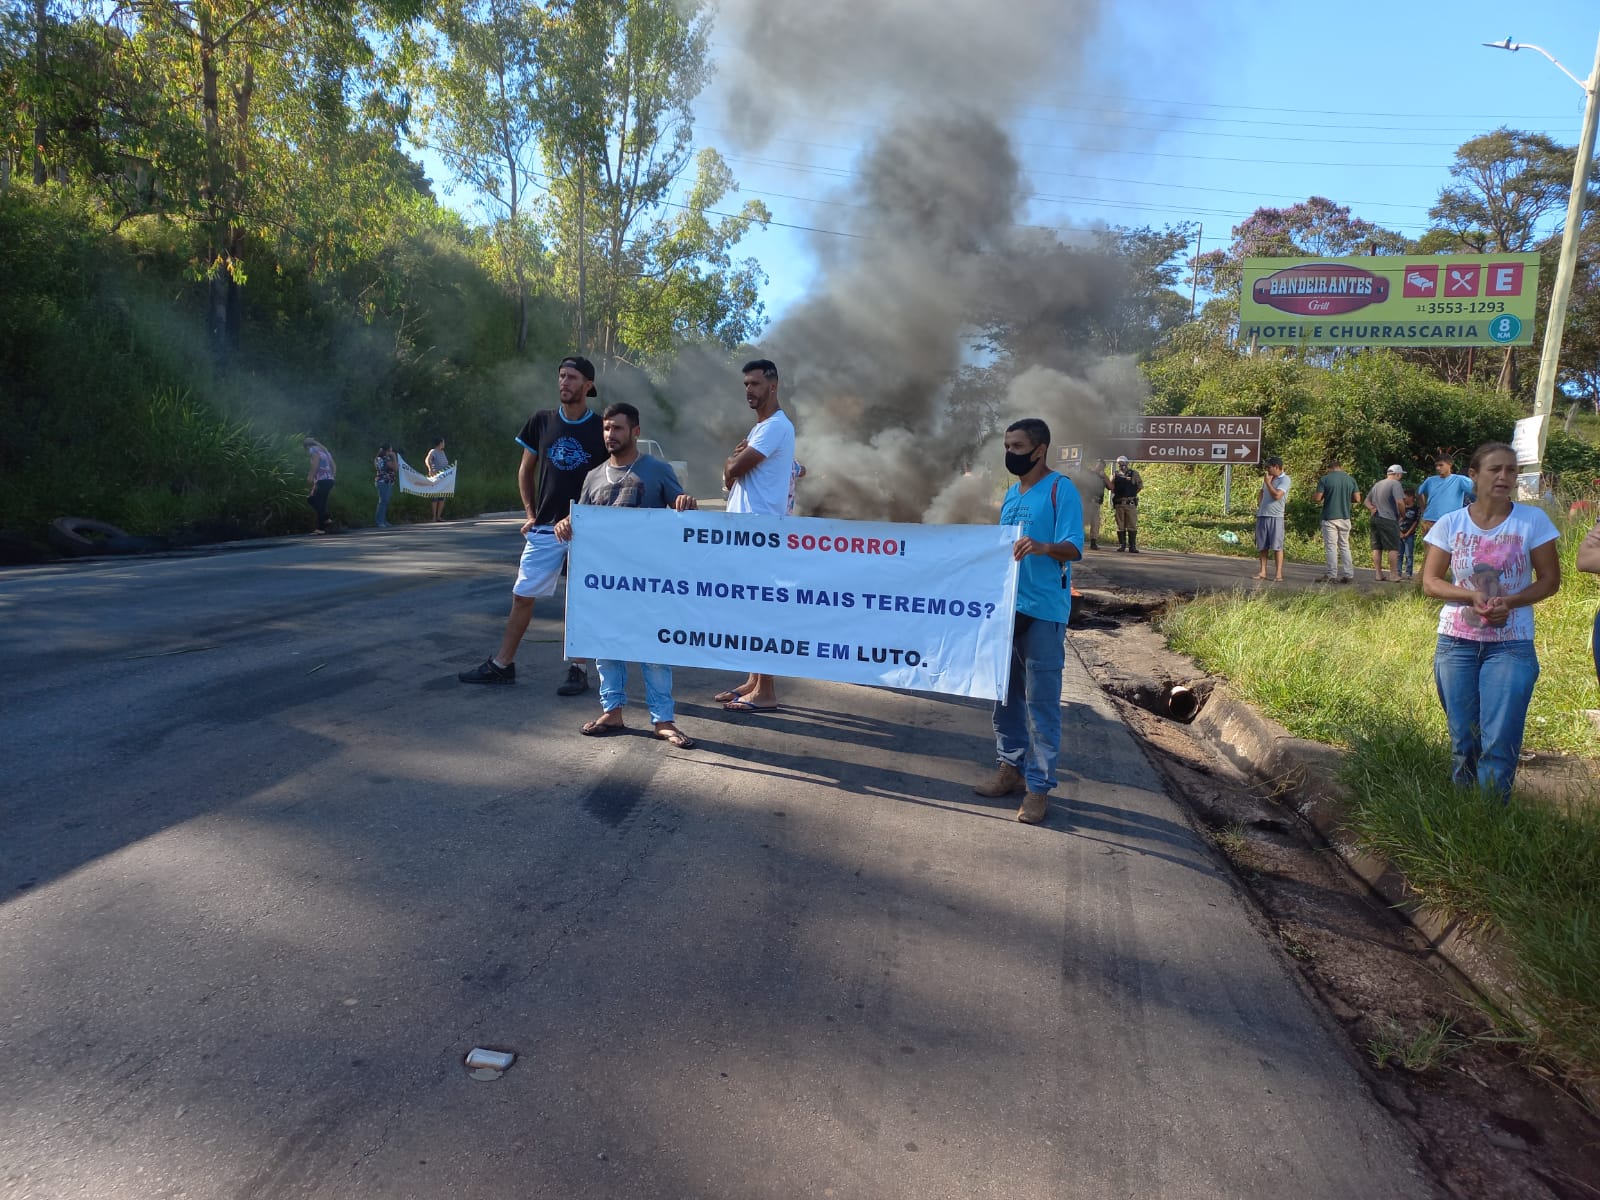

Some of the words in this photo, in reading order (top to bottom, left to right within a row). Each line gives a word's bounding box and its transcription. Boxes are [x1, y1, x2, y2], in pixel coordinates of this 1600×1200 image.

[1269, 276, 1373, 295] BANDEIRANTES
[1495, 268, 1514, 291] E
[1308, 300, 1330, 311] Grill
[1427, 301, 1505, 314] 3553-1293
[1249, 326, 1306, 338] HOTEL
[1313, 326, 1323, 338] E
[1329, 325, 1478, 338] CHURRASCARIA
[1500, 318, 1510, 332] 8
[1119, 422, 1147, 433] REG.
[1150, 423, 1211, 435] ESTRADA
[1217, 423, 1254, 435] REAL
[1149, 445, 1205, 457] Coelhos
[683, 527, 781, 549] PEDIMOS
[787, 533, 905, 556] SOCORRO!
[584, 573, 690, 595] QUANTAS
[696, 581, 790, 603] MORTES
[796, 588, 855, 608] MAIS
[862, 593, 996, 619] TEREMOS?
[657, 628, 810, 656] COMUNIDADE
[816, 642, 850, 660] EM
[857, 646, 928, 667] LUTO.
